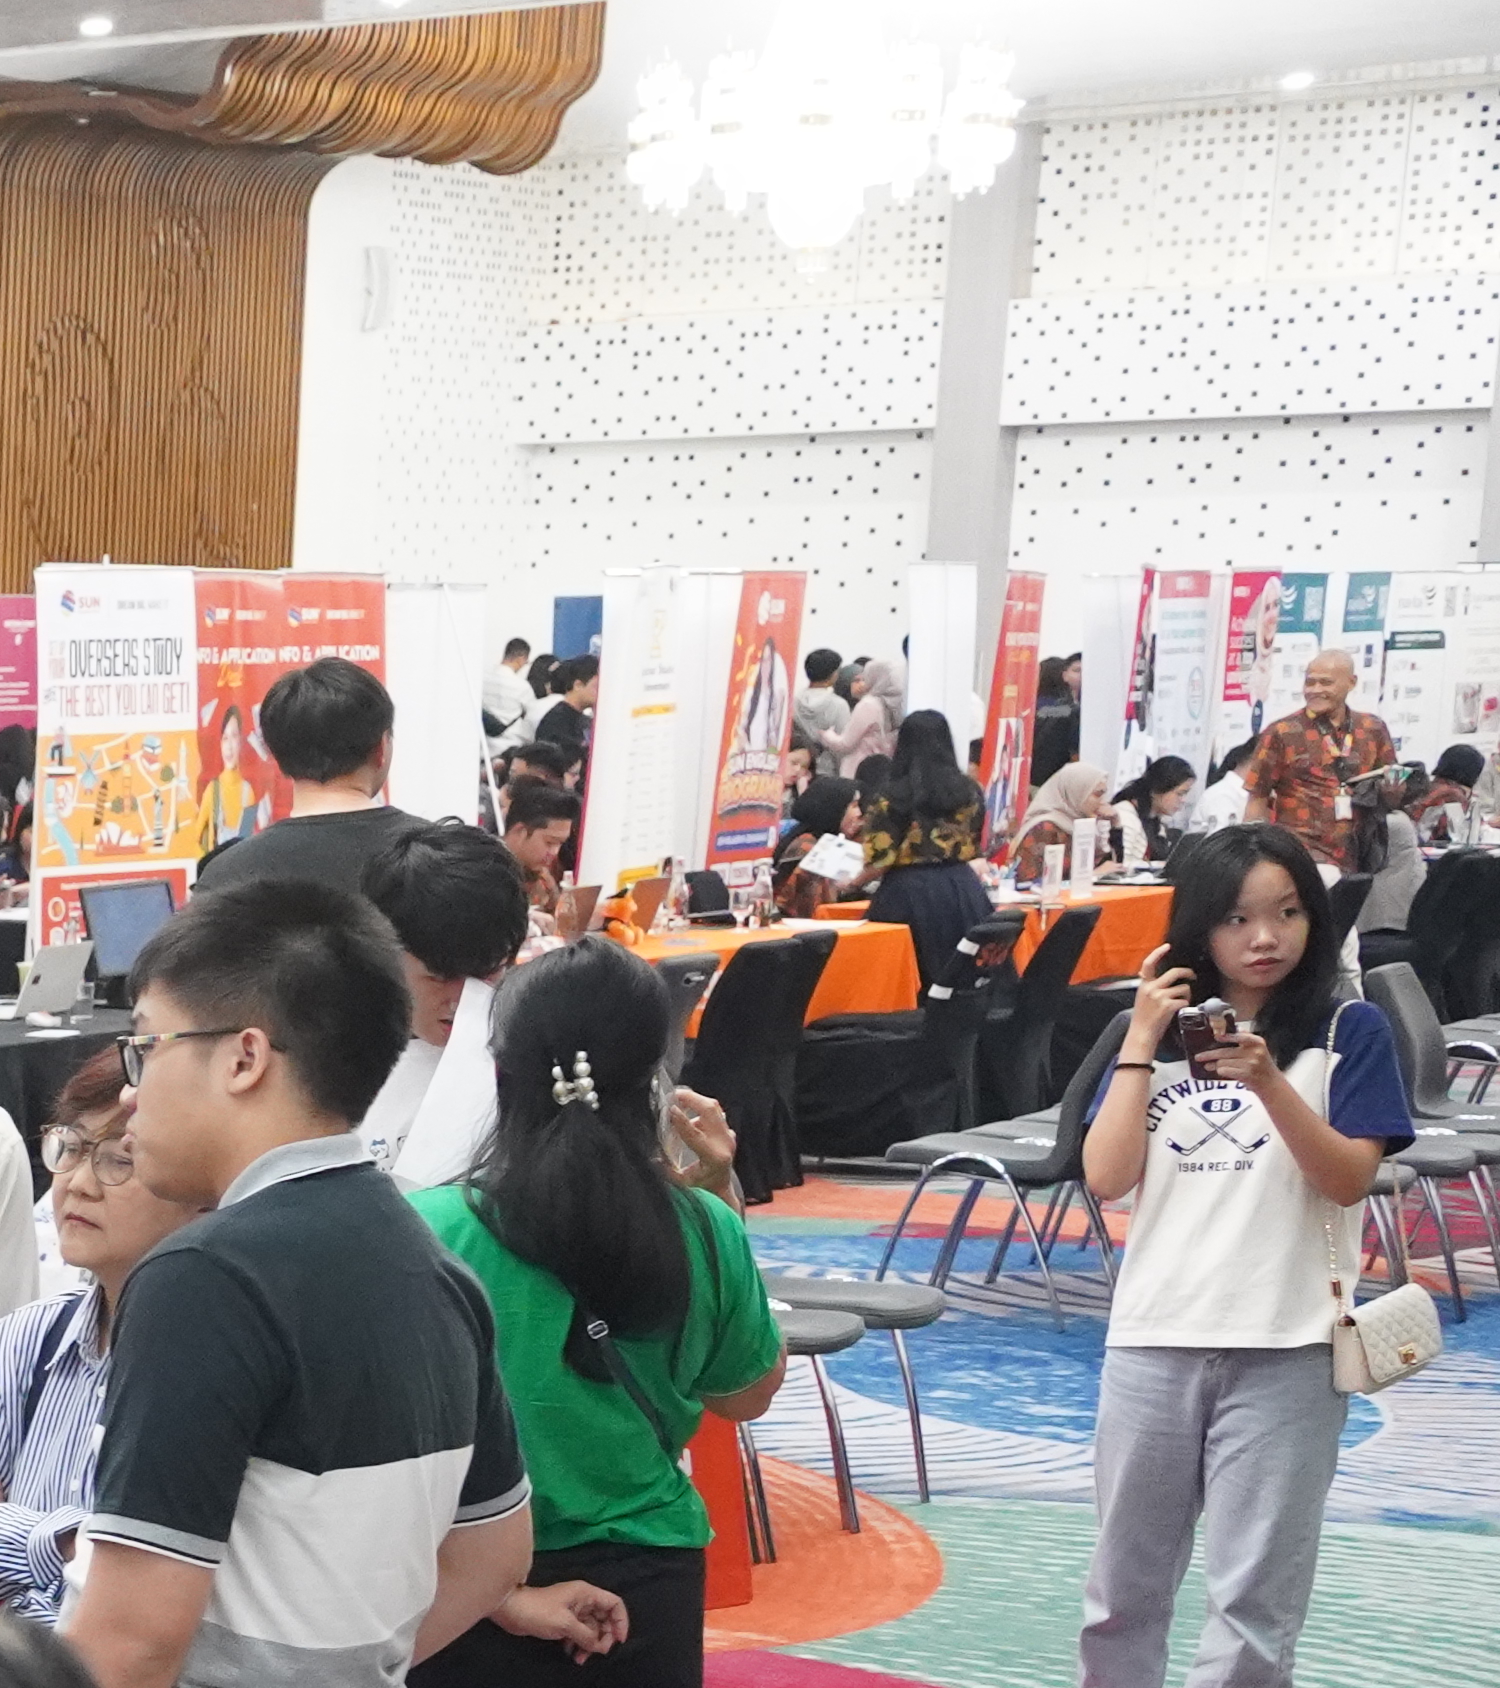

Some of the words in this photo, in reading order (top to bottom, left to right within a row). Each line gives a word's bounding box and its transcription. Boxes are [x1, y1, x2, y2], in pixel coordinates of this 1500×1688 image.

[78, 597, 100, 609] SUN
[69, 638, 139, 678] OVERSEAS
[143, 637, 183, 676] STUDY
[59, 685, 80, 718] THE
[85, 684, 111, 717] BEST
[115, 684, 137, 716] YOU
[163, 682, 190, 714] GET!
[1210, 1100, 1233, 1111] 88
[1178, 1163, 1203, 1173] 1984
[1208, 1162, 1230, 1172] REC.
[1235, 1160, 1255, 1171] DIV.
